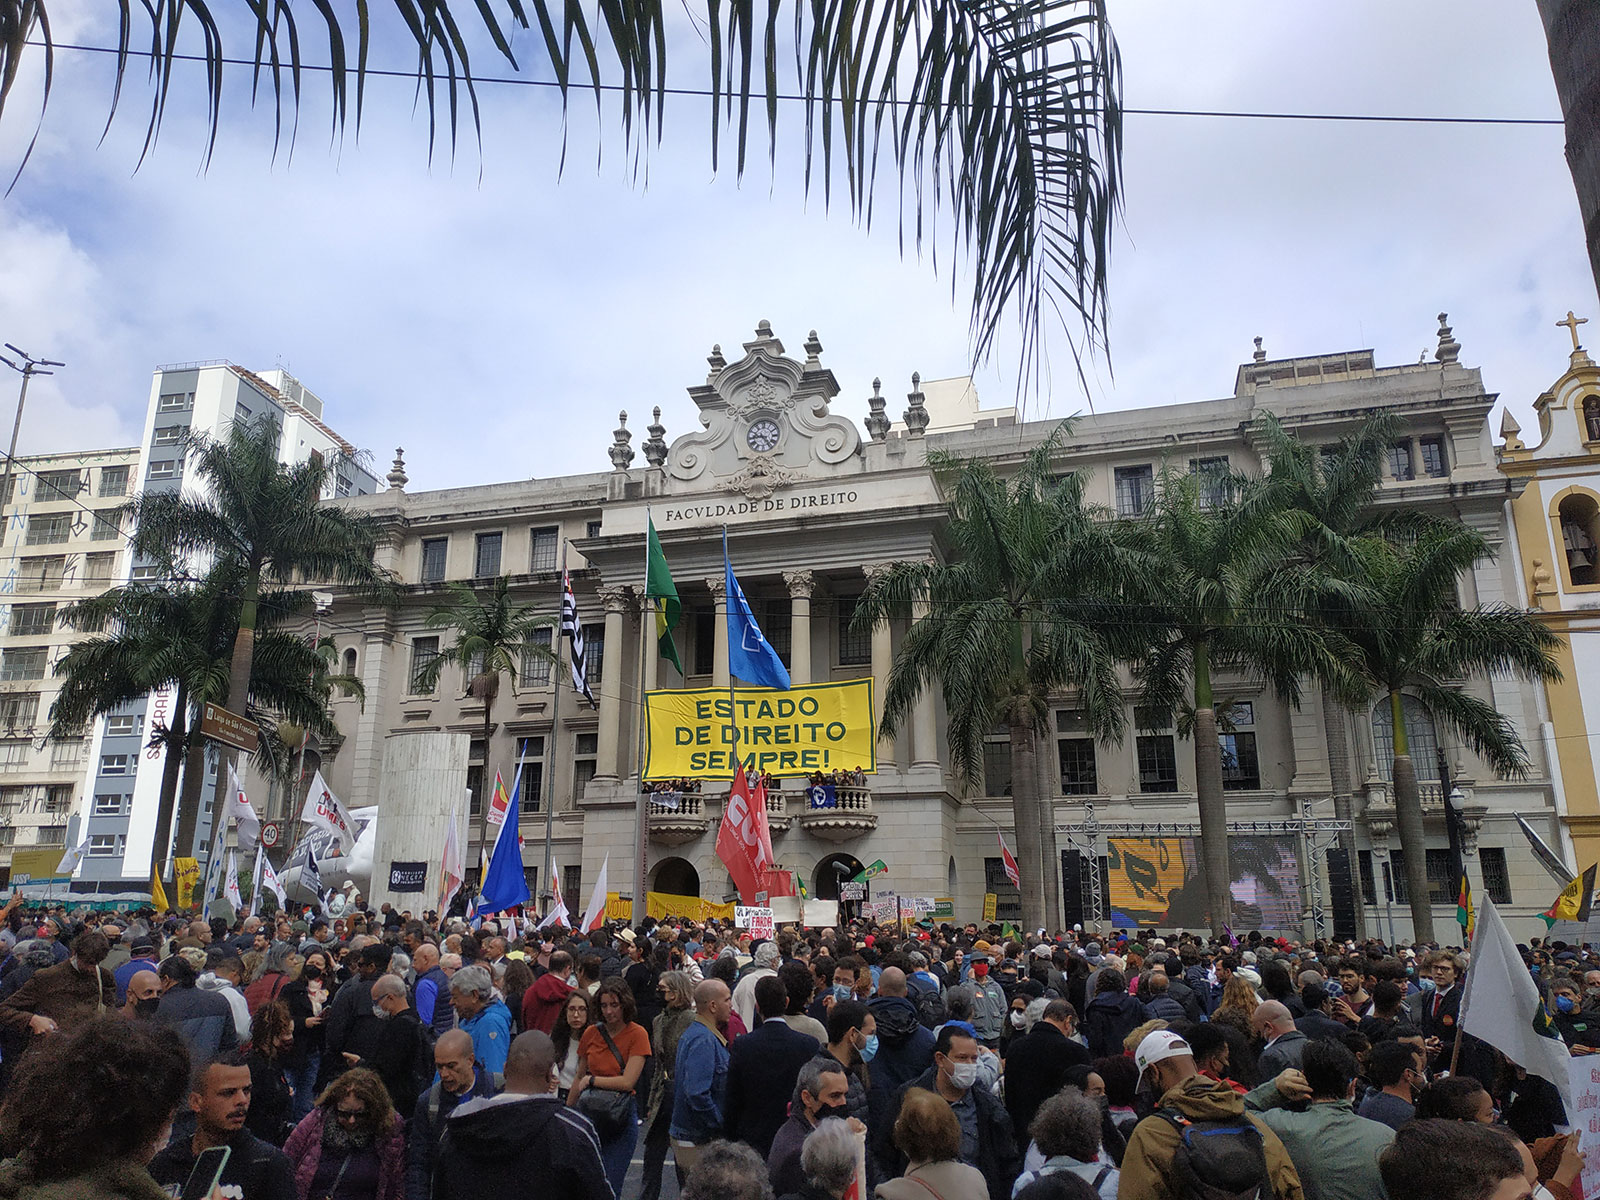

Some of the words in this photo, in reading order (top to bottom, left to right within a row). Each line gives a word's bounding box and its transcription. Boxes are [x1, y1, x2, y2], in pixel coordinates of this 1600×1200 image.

[666, 502, 758, 521] FACVLDADE
[764, 498, 785, 512] DE
[790, 491, 858, 509] DIREITO
[696, 696, 819, 720] ESTADO
[213, 712, 225, 724] Largo
[231, 719, 239, 729] São
[239, 722, 257, 737] Francisco
[675, 725, 711, 746] DE
[721, 721, 846, 745] DIREITO
[690, 749, 830, 771] SEMPRE!
[316, 804, 346, 831] UMES
[264, 828, 276, 839] 40
[606, 900, 631, 917] VOTO
